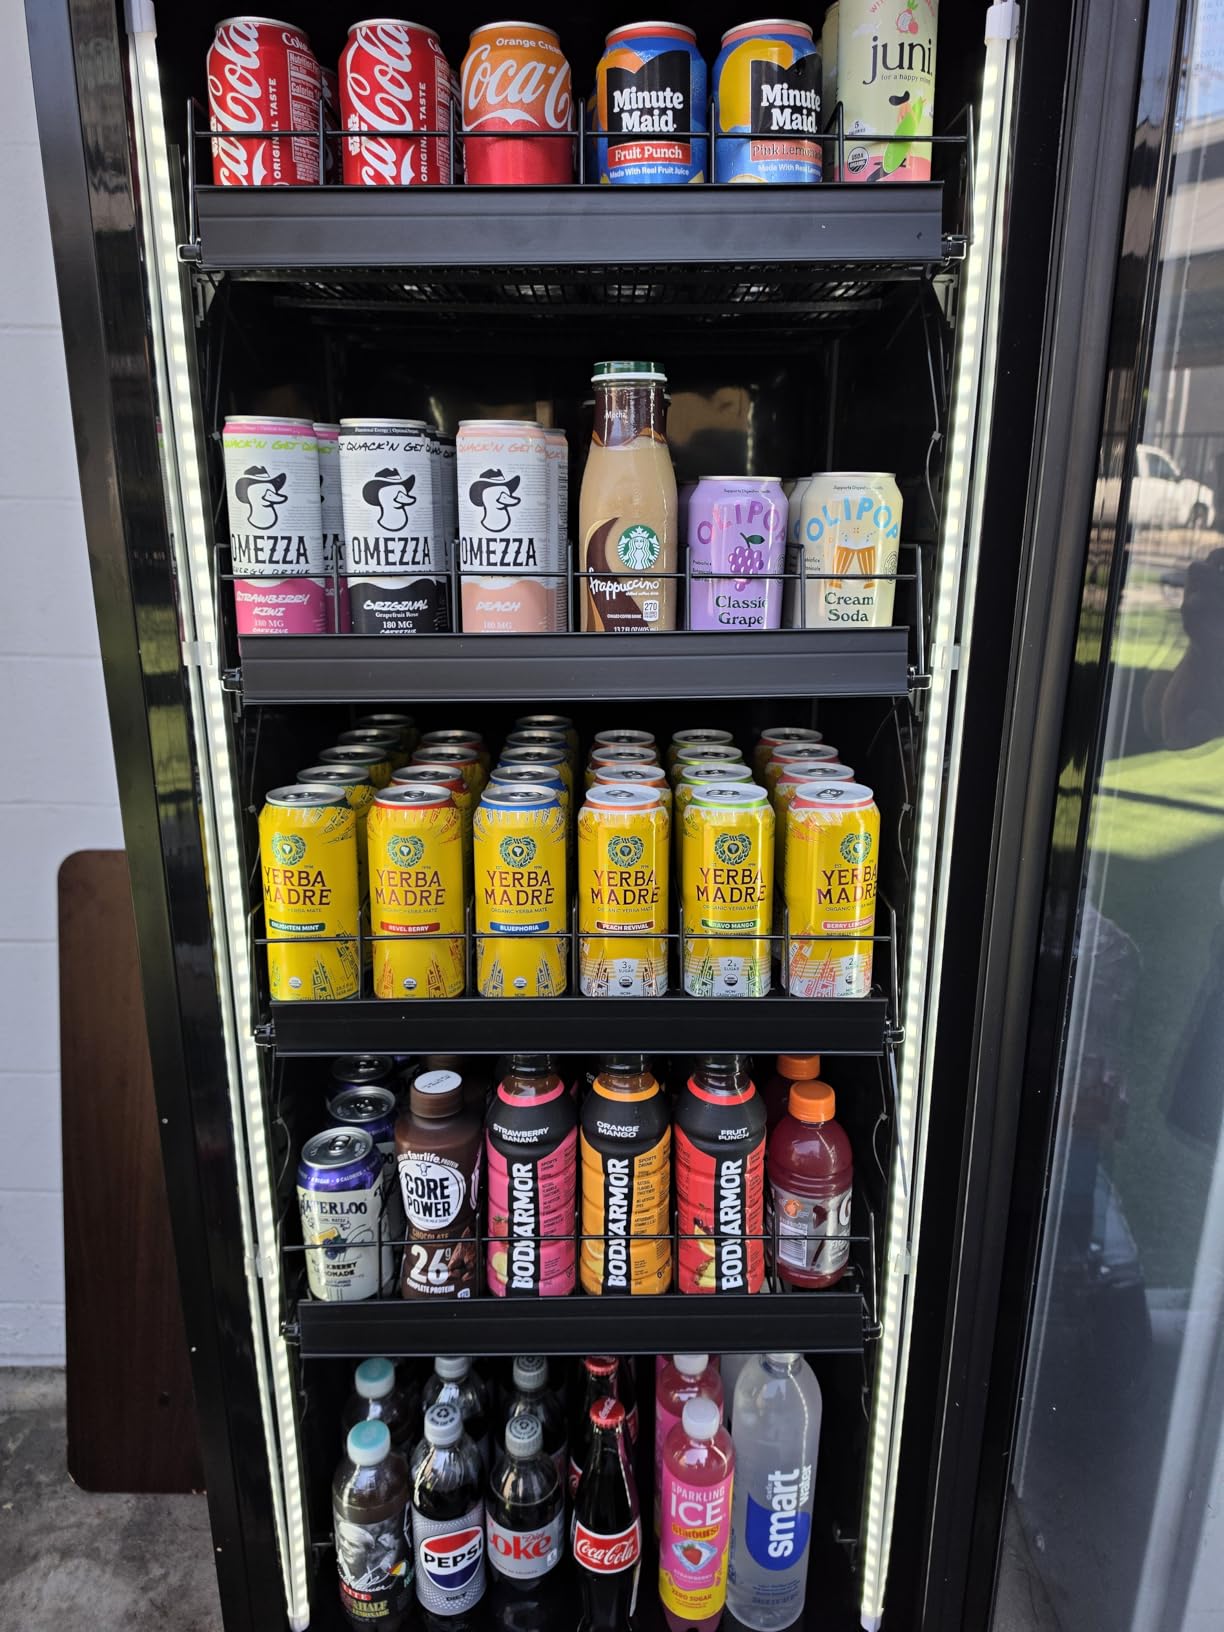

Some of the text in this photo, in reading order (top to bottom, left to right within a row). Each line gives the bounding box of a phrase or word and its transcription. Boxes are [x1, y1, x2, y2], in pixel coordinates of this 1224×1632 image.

[496, 38, 536, 48] Orange
[862, 35, 932, 85] juni
[899, 73, 918, 82] happy
[462, 44, 571, 131] Coca-C
[207, 23, 264, 185] ca-Cola
[268, 78, 279, 117] TASTE
[346, 24, 413, 185] ca-Cola
[613, 86, 684, 113] Minute
[761, 83, 820, 112] Minute
[621, 110, 673, 132] Maid
[771, 107, 816, 133] Maid
[418, 82, 429, 182] ORIGINAL TASTE
[615, 146, 682, 161] Fruit Punch
[753, 143, 779, 157] Pink
[625, 168, 640, 176] With
[642, 166, 656, 174] Real
[658, 166, 673, 174] Fruit
[675, 168, 690, 176] Juice
[758, 163, 777, 172] Made
[779, 163, 795, 171] With
[346, 442, 399, 452] QUACK'N
[403, 443, 424, 452] GET
[806, 496, 898, 543] OLIPOP
[352, 536, 431, 566] OMEZZA
[461, 536, 537, 566] OMEZZA
[237, 591, 310, 605] STRAWBERRY
[363, 599, 428, 611] ORIGINAL
[644, 602, 657, 611] 270
[825, 592, 874, 606] Cream
[253, 607, 285, 616] KIWI
[375, 611, 405, 619] Grapefruit
[718, 612, 763, 628] Grape
[828, 608, 869, 622] Soda
[269, 619, 284, 628] MG
[264, 866, 326, 887] YERBA
[376, 869, 441, 887] YERBA
[487, 870, 551, 887] YERBA
[594, 870, 656, 887] YERBA
[700, 868, 763, 884] YERBA
[264, 884, 331, 905] MADRE
[376, 888, 445, 906] MADRE
[484, 888, 554, 905] MADRE
[591, 887, 660, 905] MADRE
[696, 885, 766, 903] MADRE
[493, 1123, 549, 1137] STRAWBERRY
[597, 1121, 639, 1132] ORANGE
[598, 1128, 636, 1138] MANGO
[721, 1127, 747, 1136] FRUIT
[502, 1133, 538, 1143] BANANA
[718, 1132, 749, 1141] PUNCH
[441, 1158, 459, 1169] PROTEIN
[638, 1155, 656, 1163] SPORTS
[405, 1172, 450, 1200] CORE
[301, 1201, 367, 1215] AERLOO
[407, 1195, 451, 1218] POWER
[512, 1162, 535, 1289] BODYARMOR
[608, 1158, 629, 1287] BODYARMOR
[720, 1159, 743, 1290] BODYARMOR
[430, 1284, 454, 1294] PROTEIN
[672, 1481, 725, 1502] SPARKLING
[671, 1493, 724, 1526] ICE
[768, 1468, 800, 1558] smart
[799, 1464, 812, 1506] water
[424, 1537, 482, 1568] PEPSI
[490, 1533, 551, 1560] oke
[576, 1536, 636, 1566] Coca-Cola
[344, 1585, 371, 1600] LITE
[446, 1592, 467, 1601] DIET
[672, 1587, 712, 1602] ZERO SUGAR
[353, 1609, 390, 1618] LEMONADE
